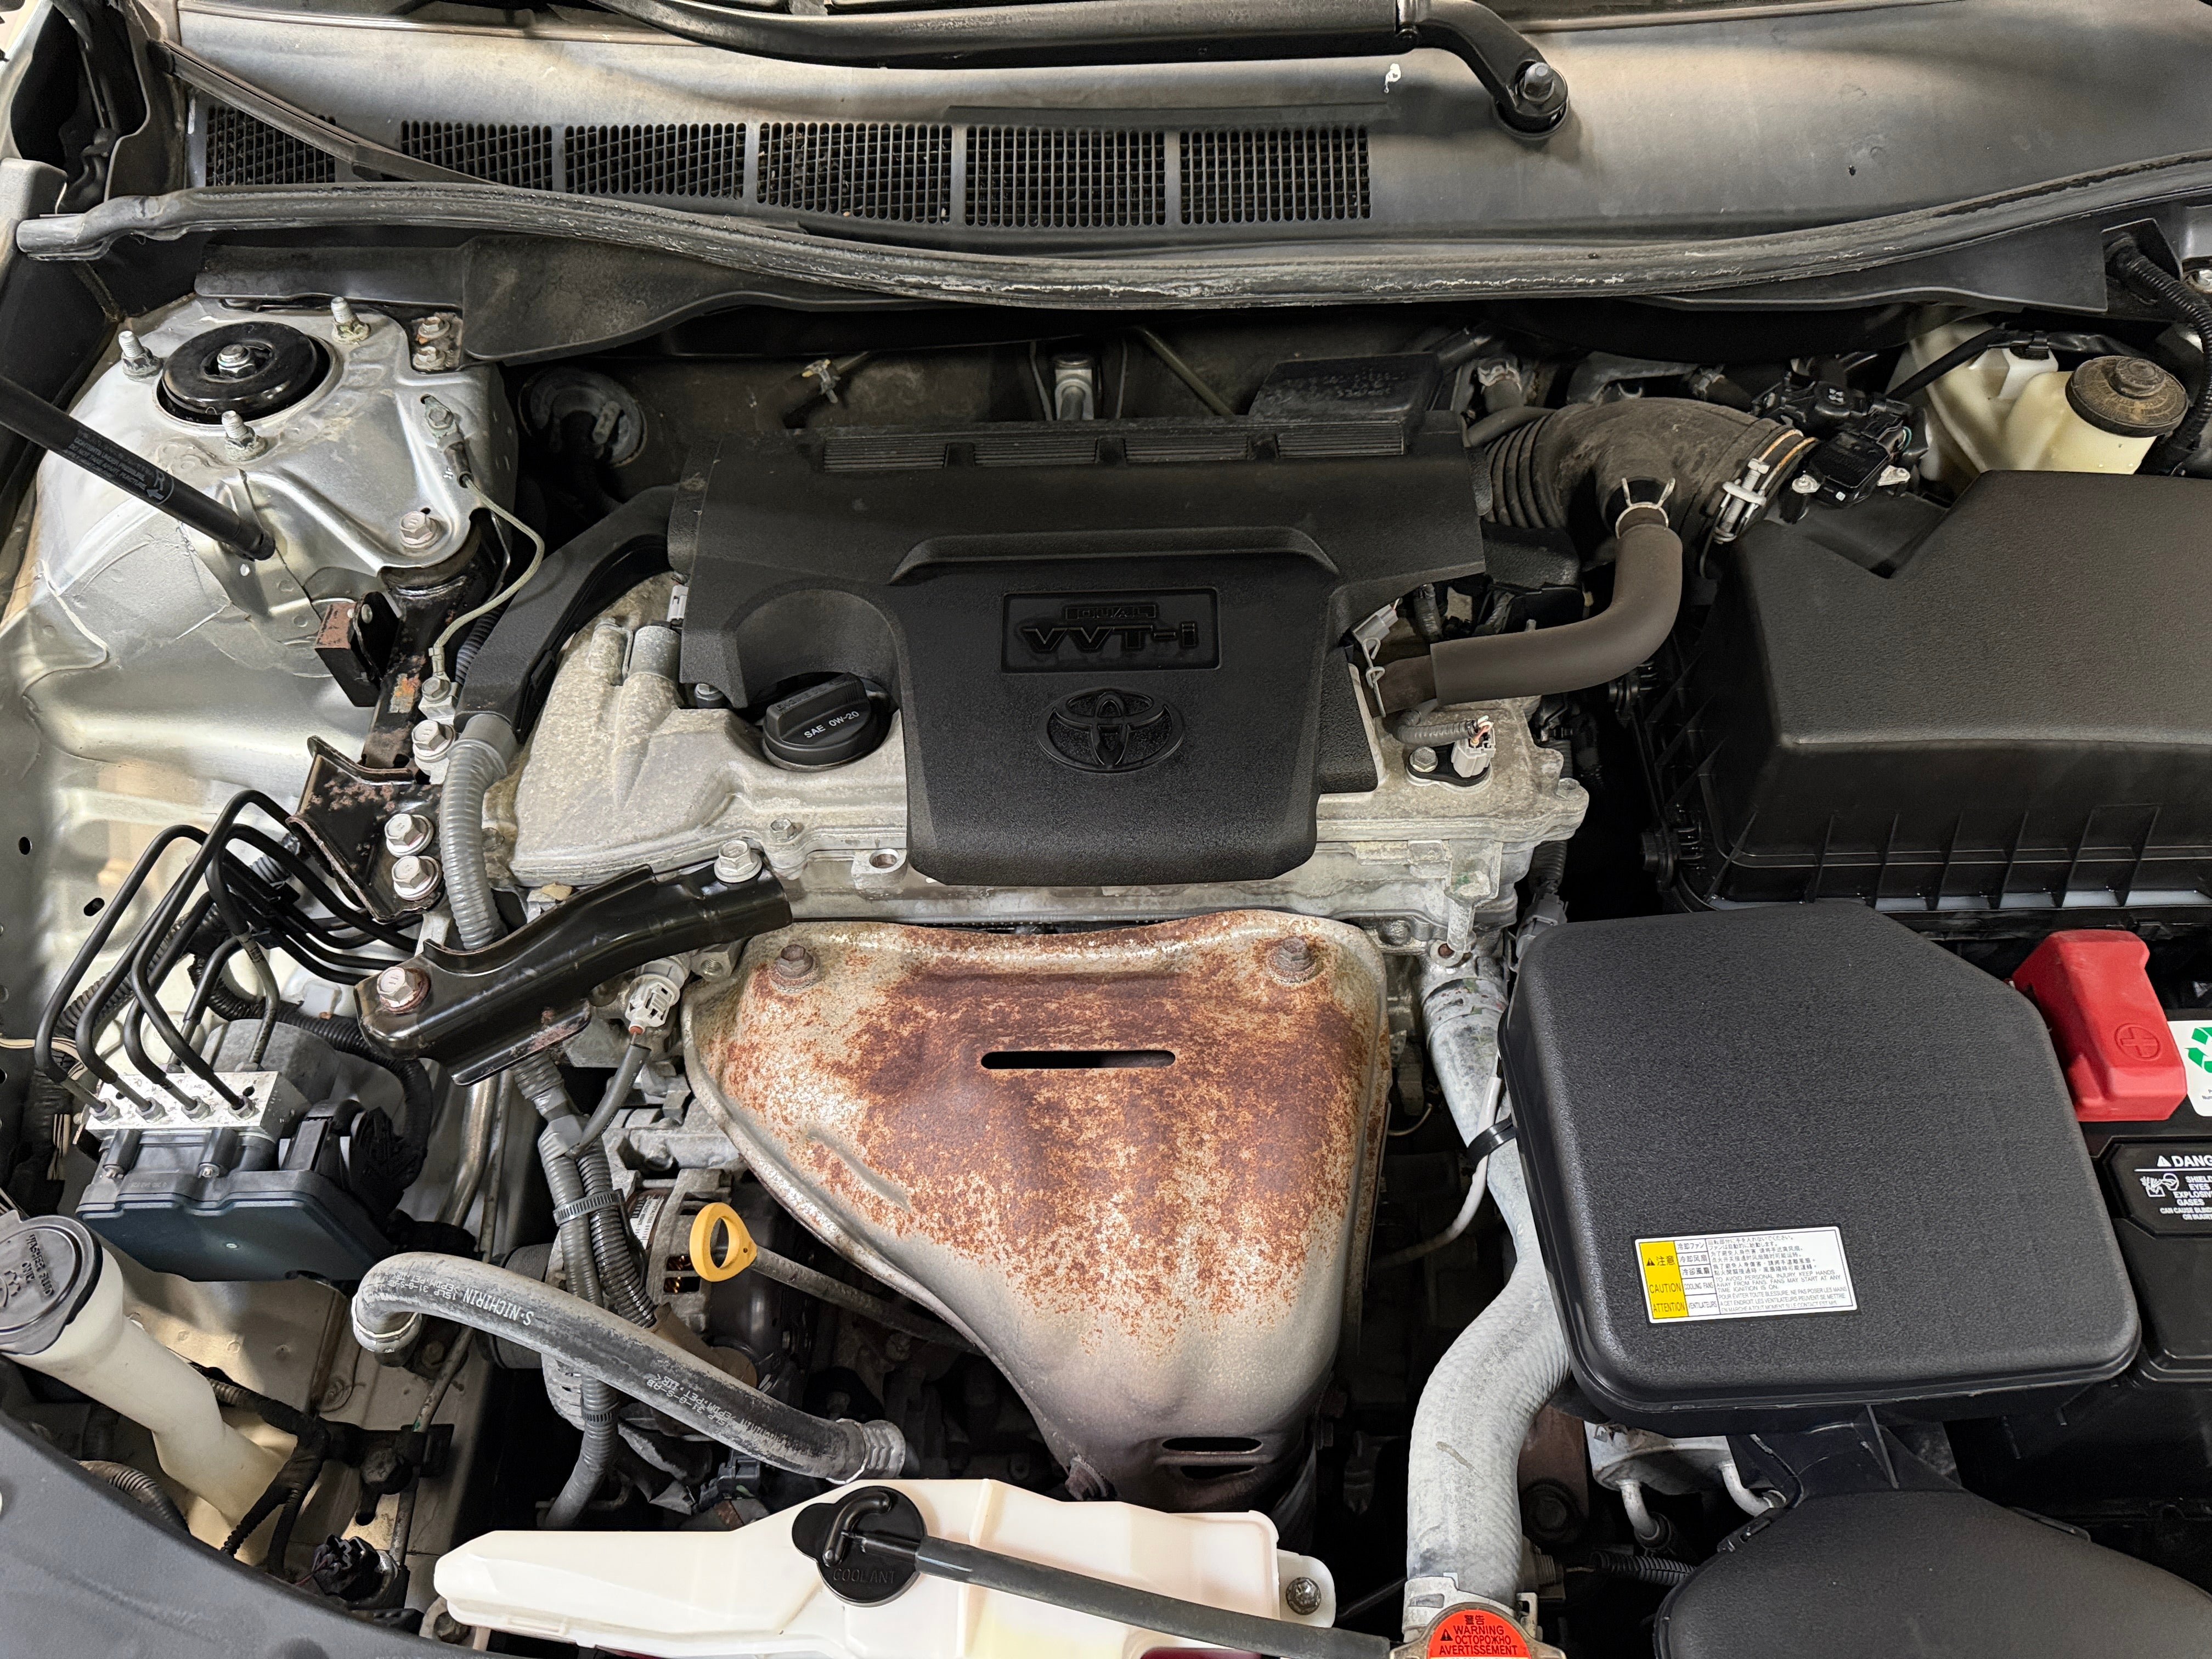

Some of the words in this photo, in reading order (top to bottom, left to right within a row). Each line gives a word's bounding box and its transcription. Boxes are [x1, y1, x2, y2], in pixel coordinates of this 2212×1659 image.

[1070, 605, 1154, 620] DUAL
[1022, 623, 1195, 651] VVT-i
[804, 724, 826, 738] SAE
[828, 711, 859, 726] 0W-20
[2171, 1154, 2212, 1167] DANG
[1677, 1242, 1705, 1250] 冷却ファン
[26, 1234, 46, 1272] WASHER
[1679, 1254, 1707, 1263] 冷却风扇
[1655, 1255, 1675, 1266] 注意
[1649, 1282, 1681, 1294] CAUTION
[1652, 1301, 1685, 1313] ATTENTION
[1688, 1301, 1718, 1309] VENTILATEURS
[833, 1567, 895, 1584] COOLANT
[1464, 1615, 1485, 1626] 警告
[1453, 1625, 1504, 1635] WARNING
[1455, 1635, 1511, 1645] ОСТОРОЖНО
[1439, 1645, 1517, 1655] AVERTISSEMENT
